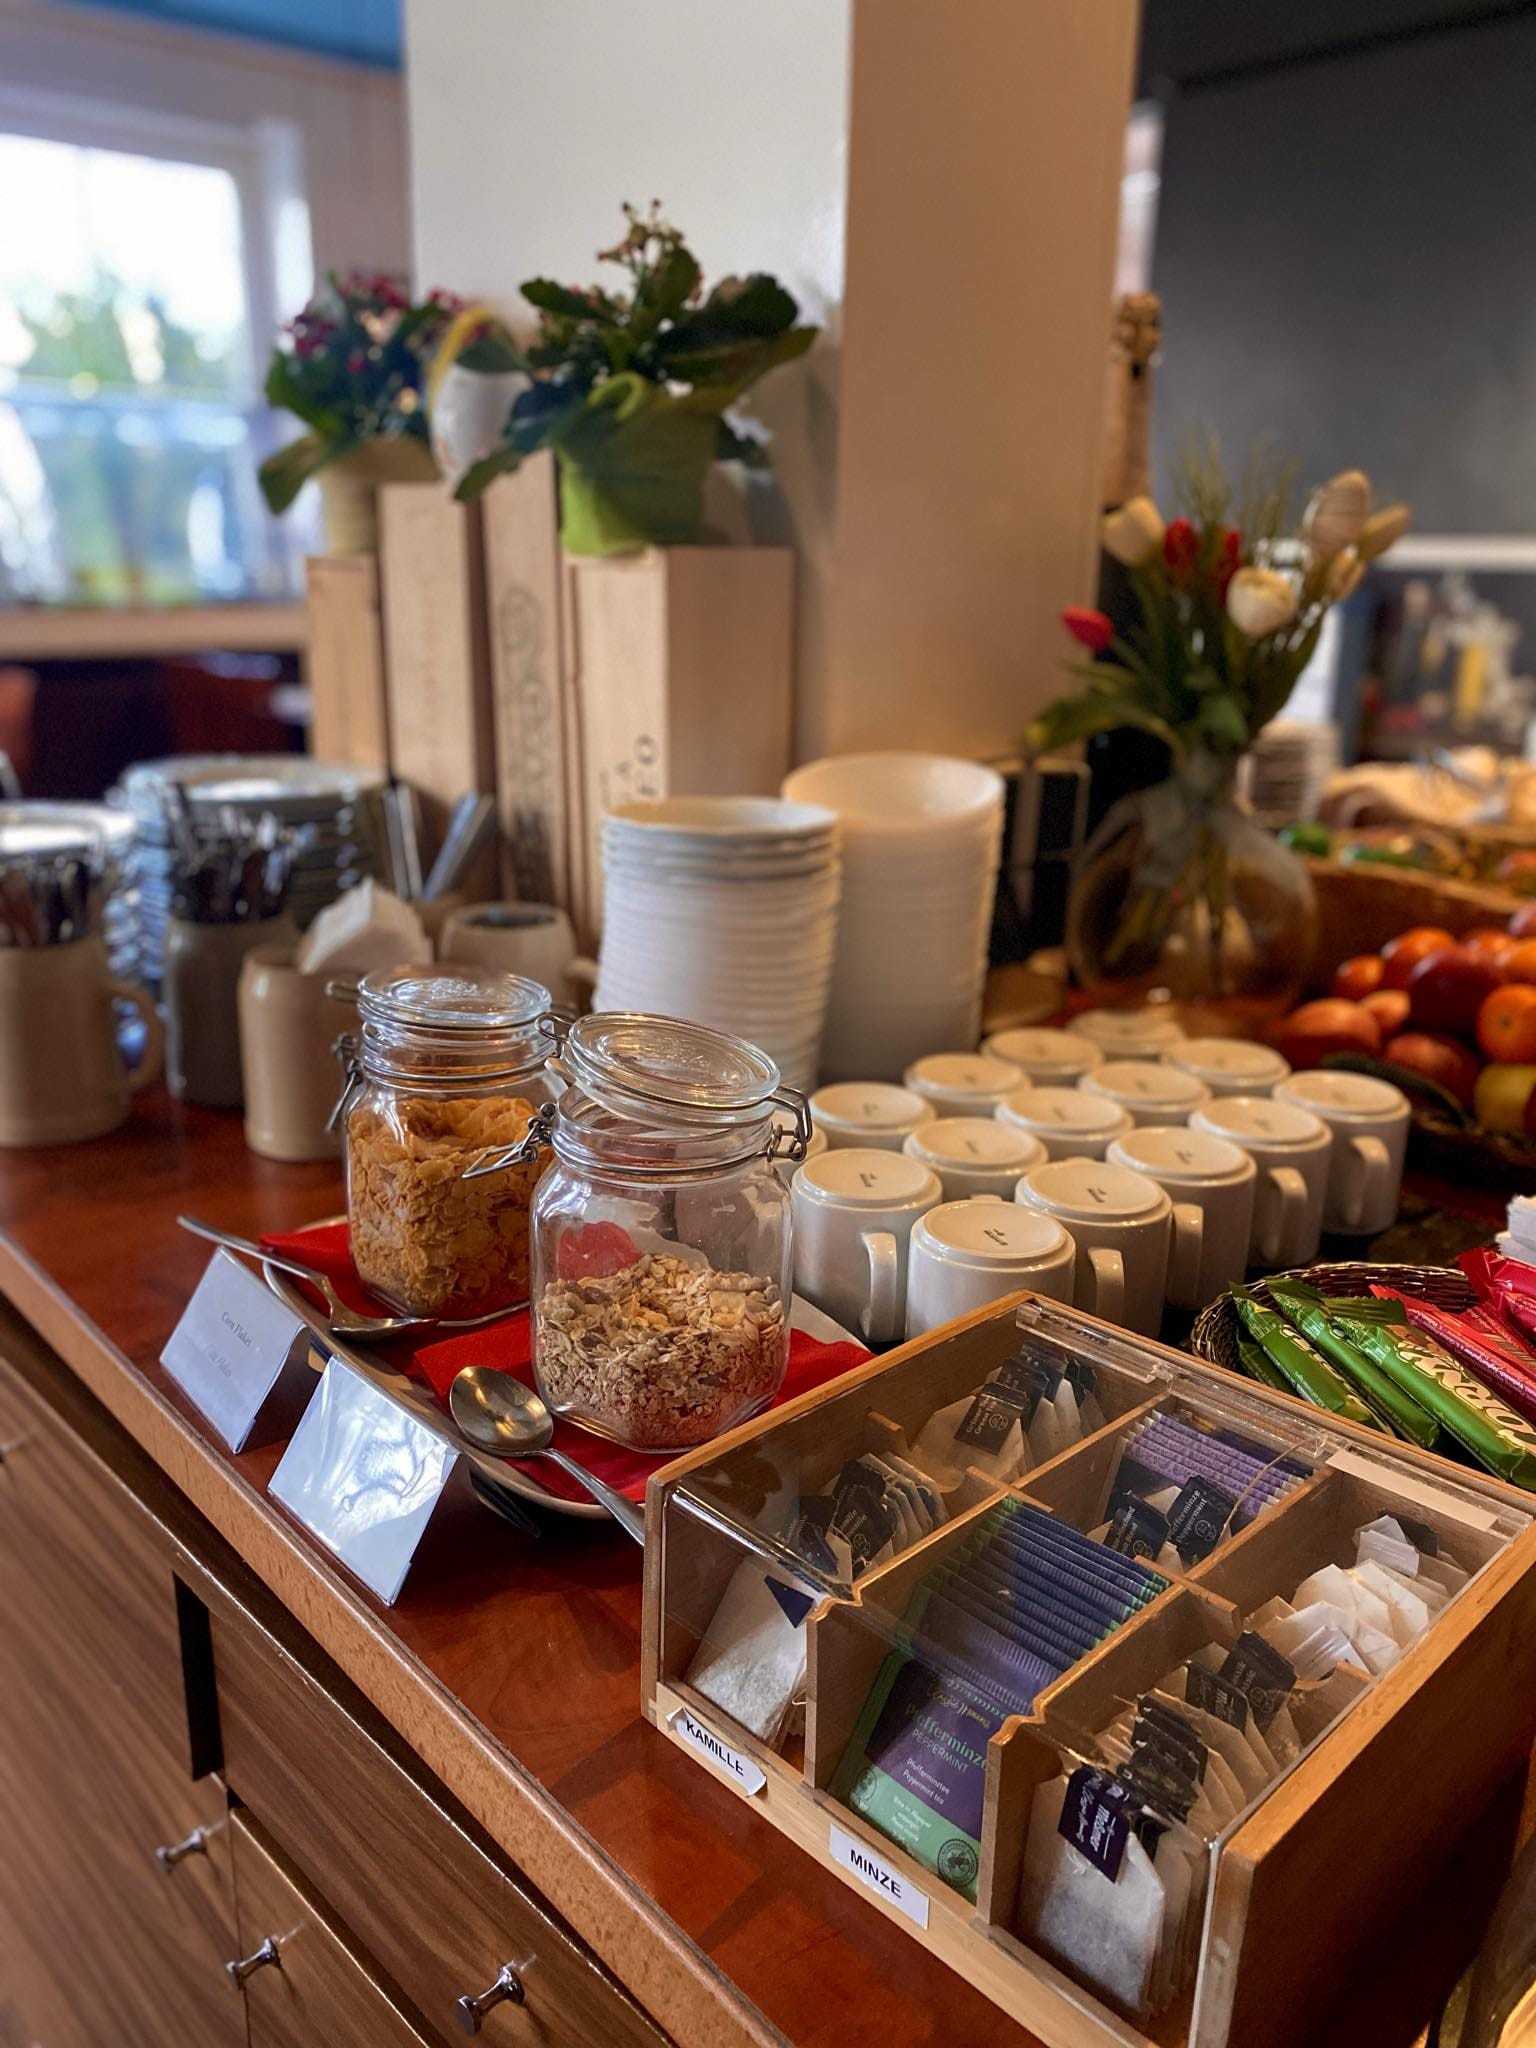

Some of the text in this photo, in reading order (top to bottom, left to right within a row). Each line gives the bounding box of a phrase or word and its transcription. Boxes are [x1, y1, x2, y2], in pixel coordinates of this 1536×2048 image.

[686, 1719, 745, 1777] KAMILLE
[912, 1728, 969, 1774] PEPPERMINT
[850, 1849, 902, 1900] MINZE
